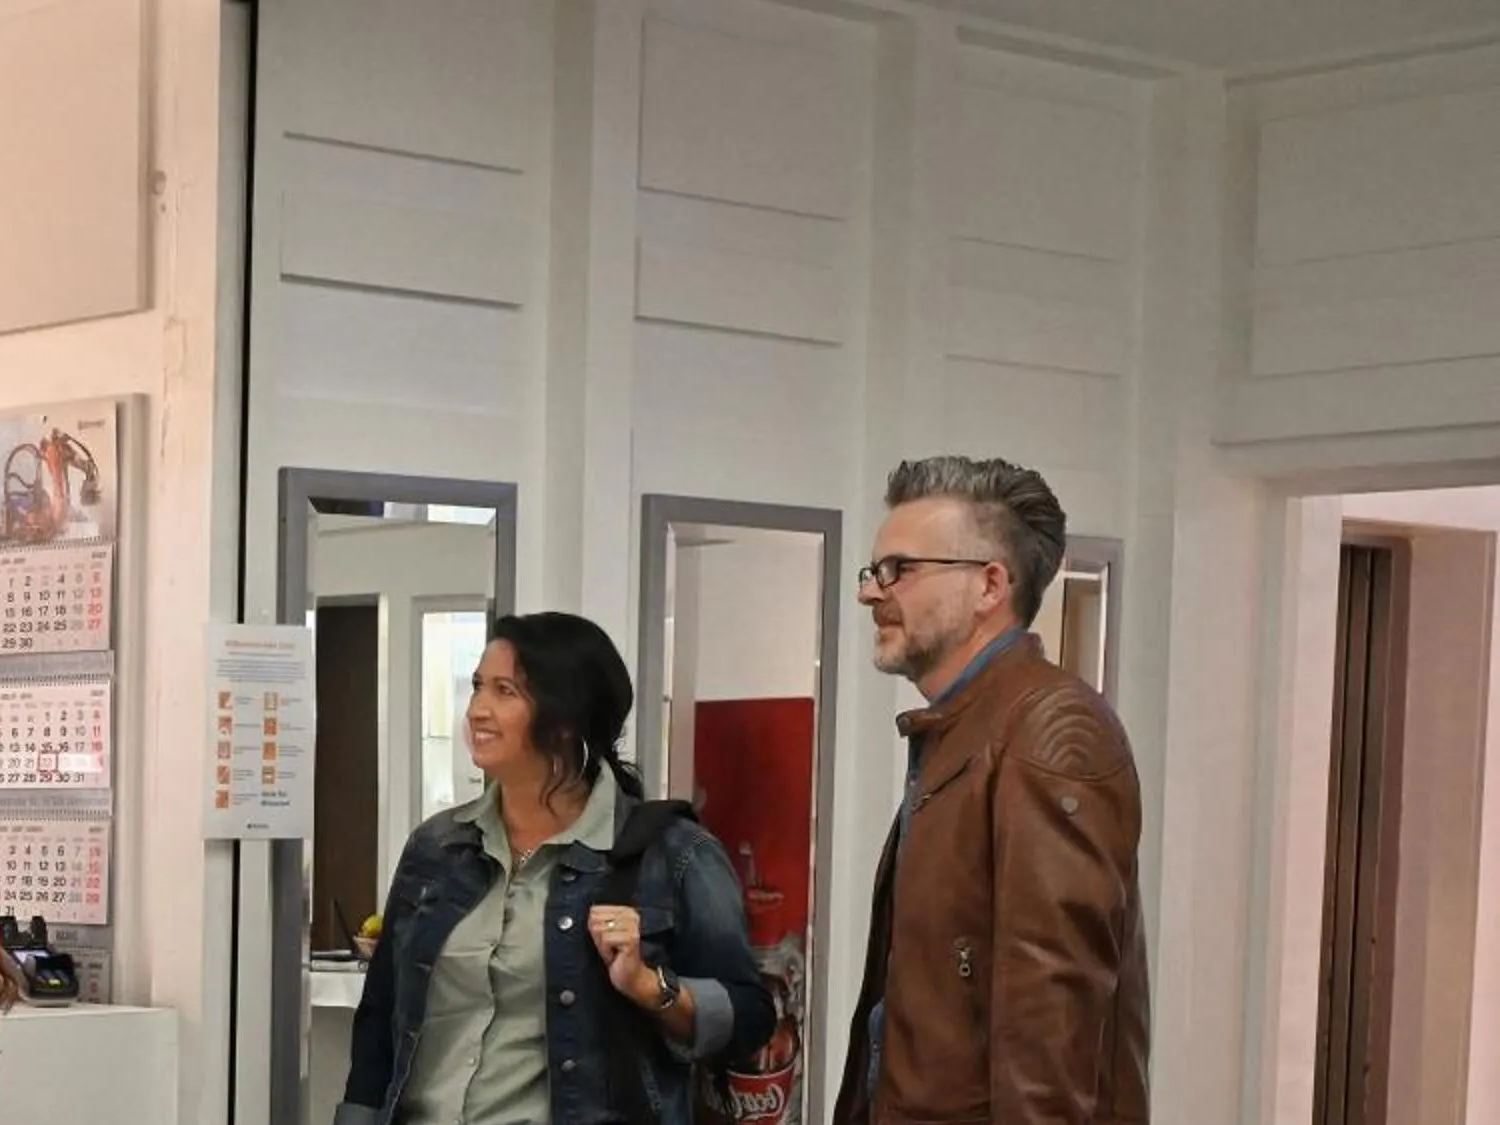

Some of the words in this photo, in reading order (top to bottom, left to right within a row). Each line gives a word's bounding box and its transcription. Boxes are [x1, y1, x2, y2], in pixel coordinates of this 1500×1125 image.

[38, 589, 51, 601] 10
[57, 589, 66, 600] 11
[21, 606, 33, 617] 16
[38, 605, 49, 616] 17
[55, 605, 67, 616] 18
[3, 623, 17, 633] 22
[19, 621, 33, 633] 23
[36, 620, 50, 632] 24
[53, 619, 67, 631] 25
[2, 637, 17, 649] 29
[19, 637, 33, 649] 30
[75, 724, 86, 736] 10
[93, 724, 101, 737] 11
[9, 742, 20, 753] 13
[25, 742, 36, 753] 14
[41, 742, 53, 753] 15
[58, 741, 69, 753] 16
[75, 741, 85, 753] 17
[7, 773, 20, 783] 27
[23, 773, 37, 783] 28
[39, 771, 53, 783] 29
[55, 772, 70, 783] 30
[74, 772, 85, 783] 31
[6, 860, 17, 871] 10
[24, 861, 31, 870] 11
[39, 861, 49, 871] 12
[55, 861, 66, 872] 13
[6, 876, 16, 885] 17
[21, 876, 33, 887] 18
[37, 876, 49, 887] 19
[52, 876, 66, 887] 20
[4, 890, 16, 901] 24
[19, 891, 32, 901] 25
[36, 891, 49, 901] 26
[52, 891, 66, 903] 27
